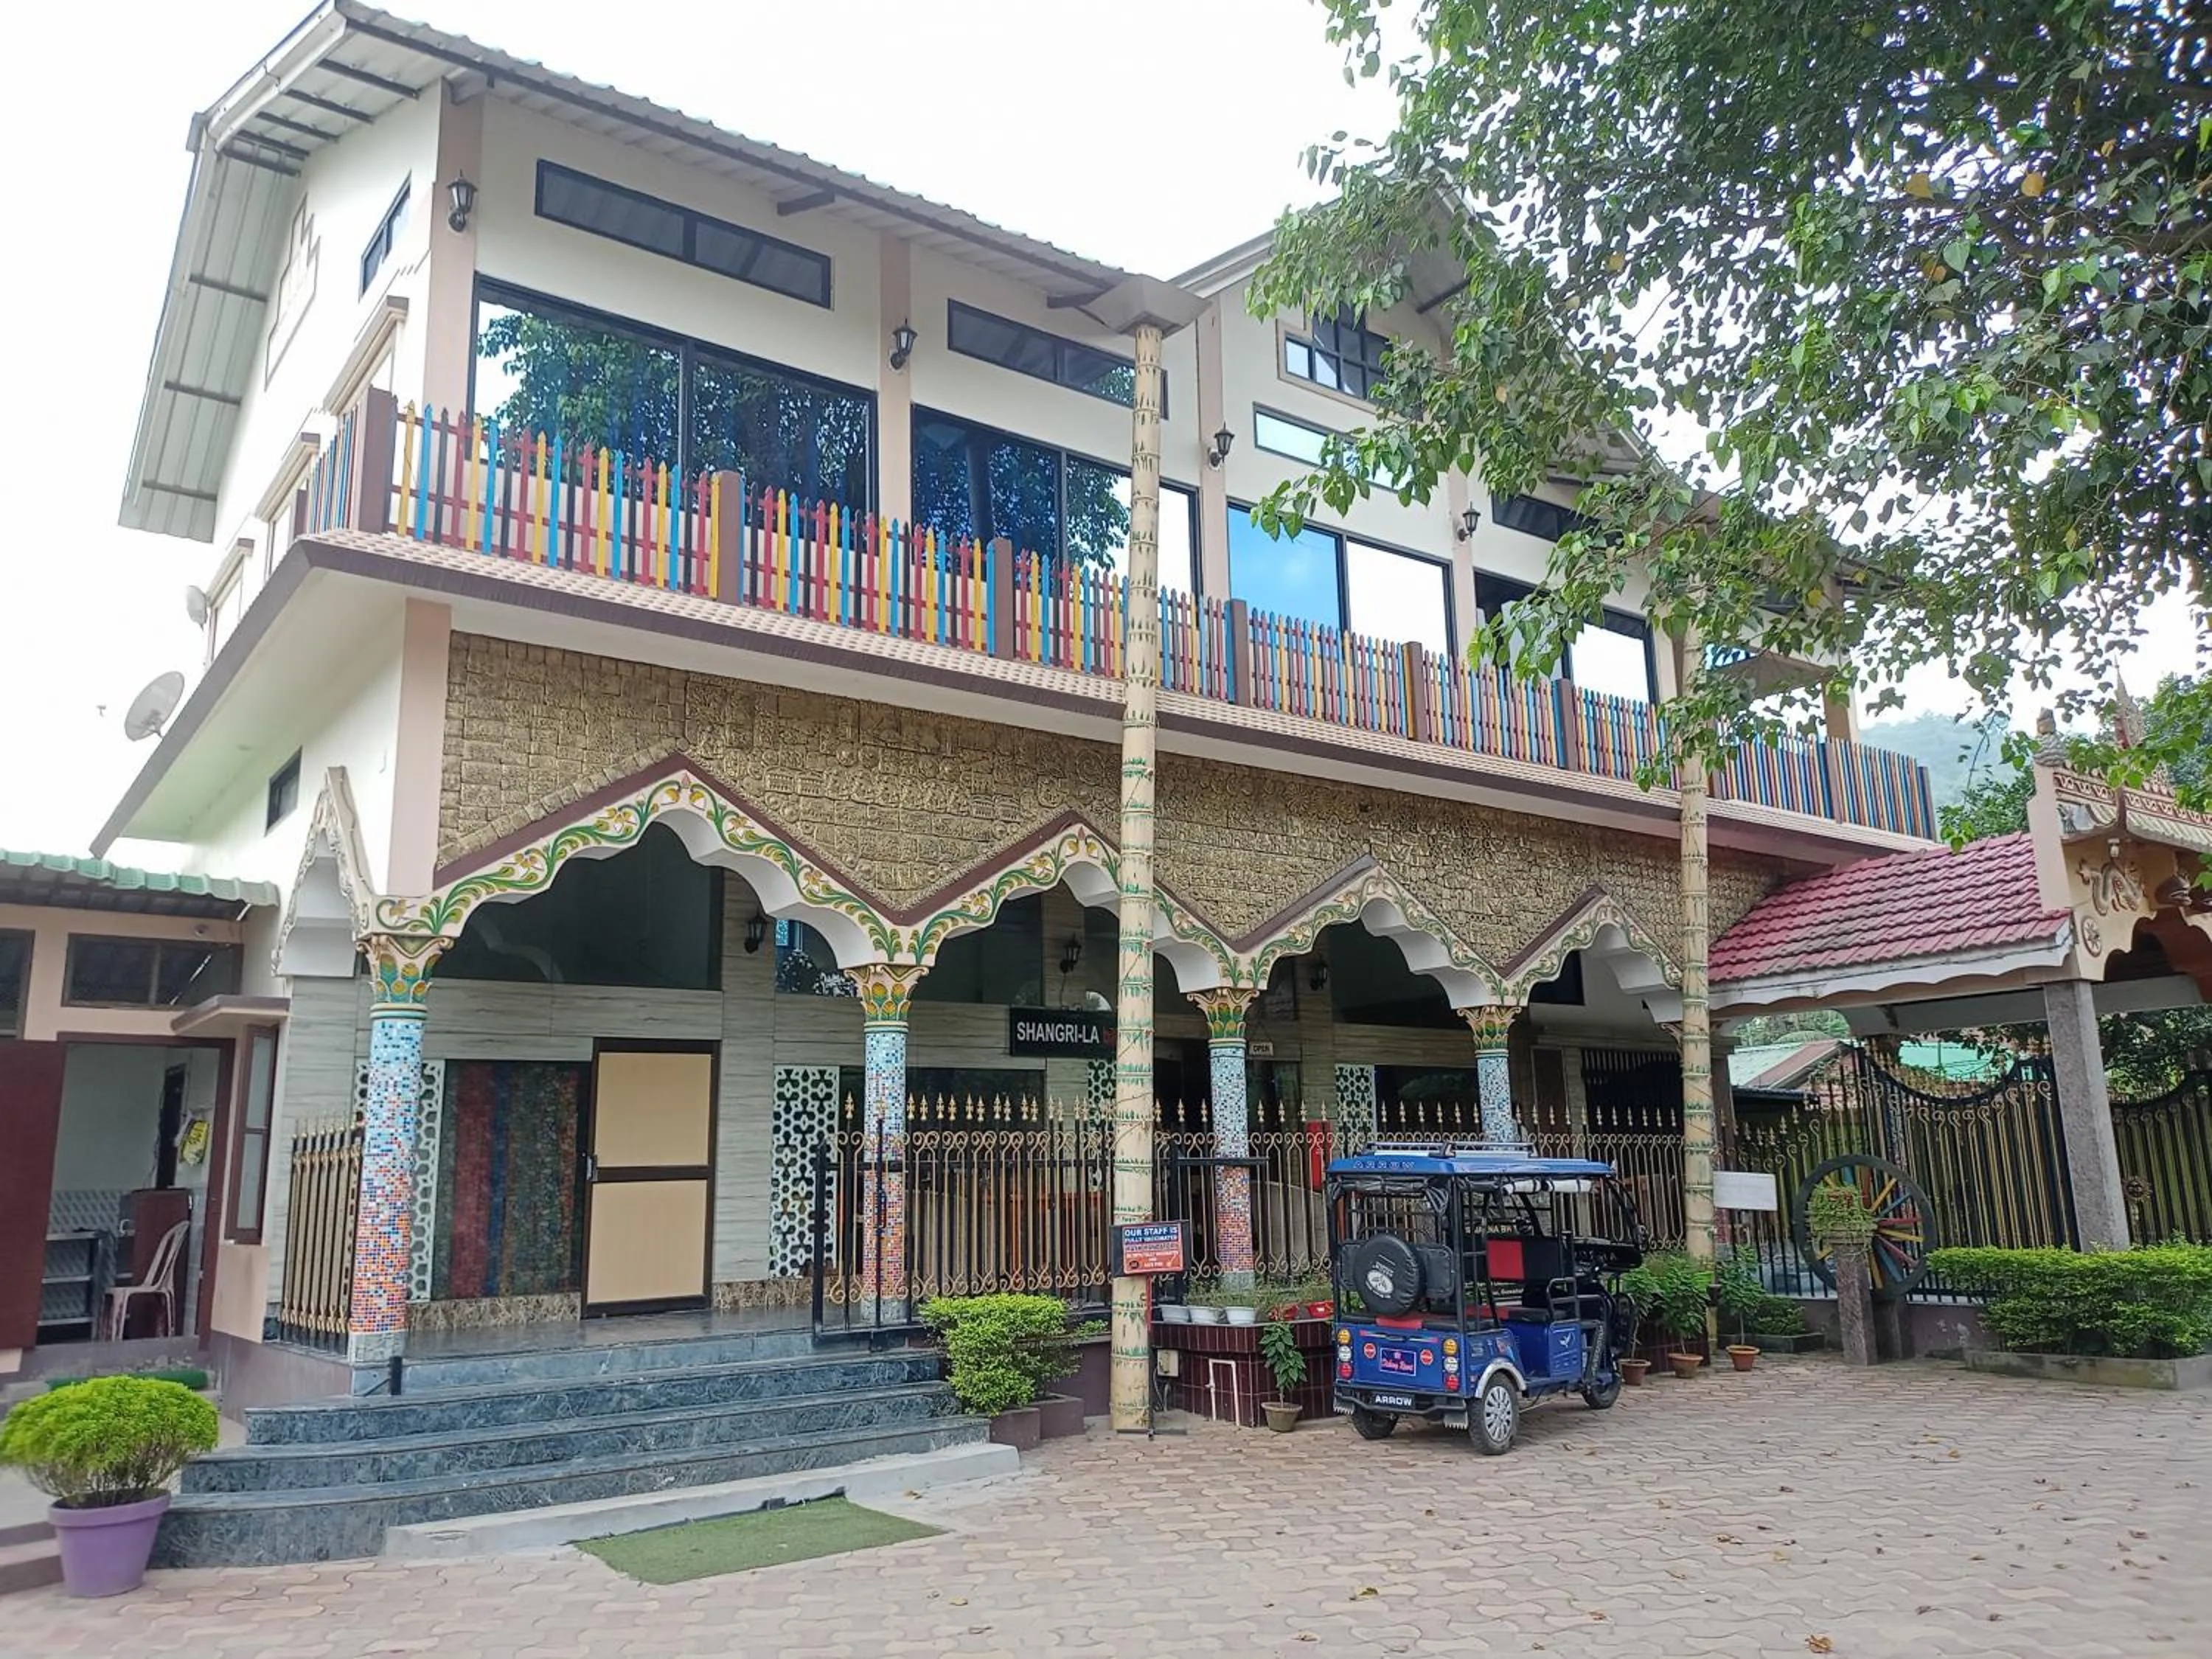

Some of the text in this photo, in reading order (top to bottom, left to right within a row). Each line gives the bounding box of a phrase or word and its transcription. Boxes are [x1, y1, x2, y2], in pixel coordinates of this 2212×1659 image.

[1017, 1022, 1099, 1044] SHANGRI-LA
[1144, 1227, 1168, 1236] STAFF
[1375, 1394, 1412, 1406] ARROW
